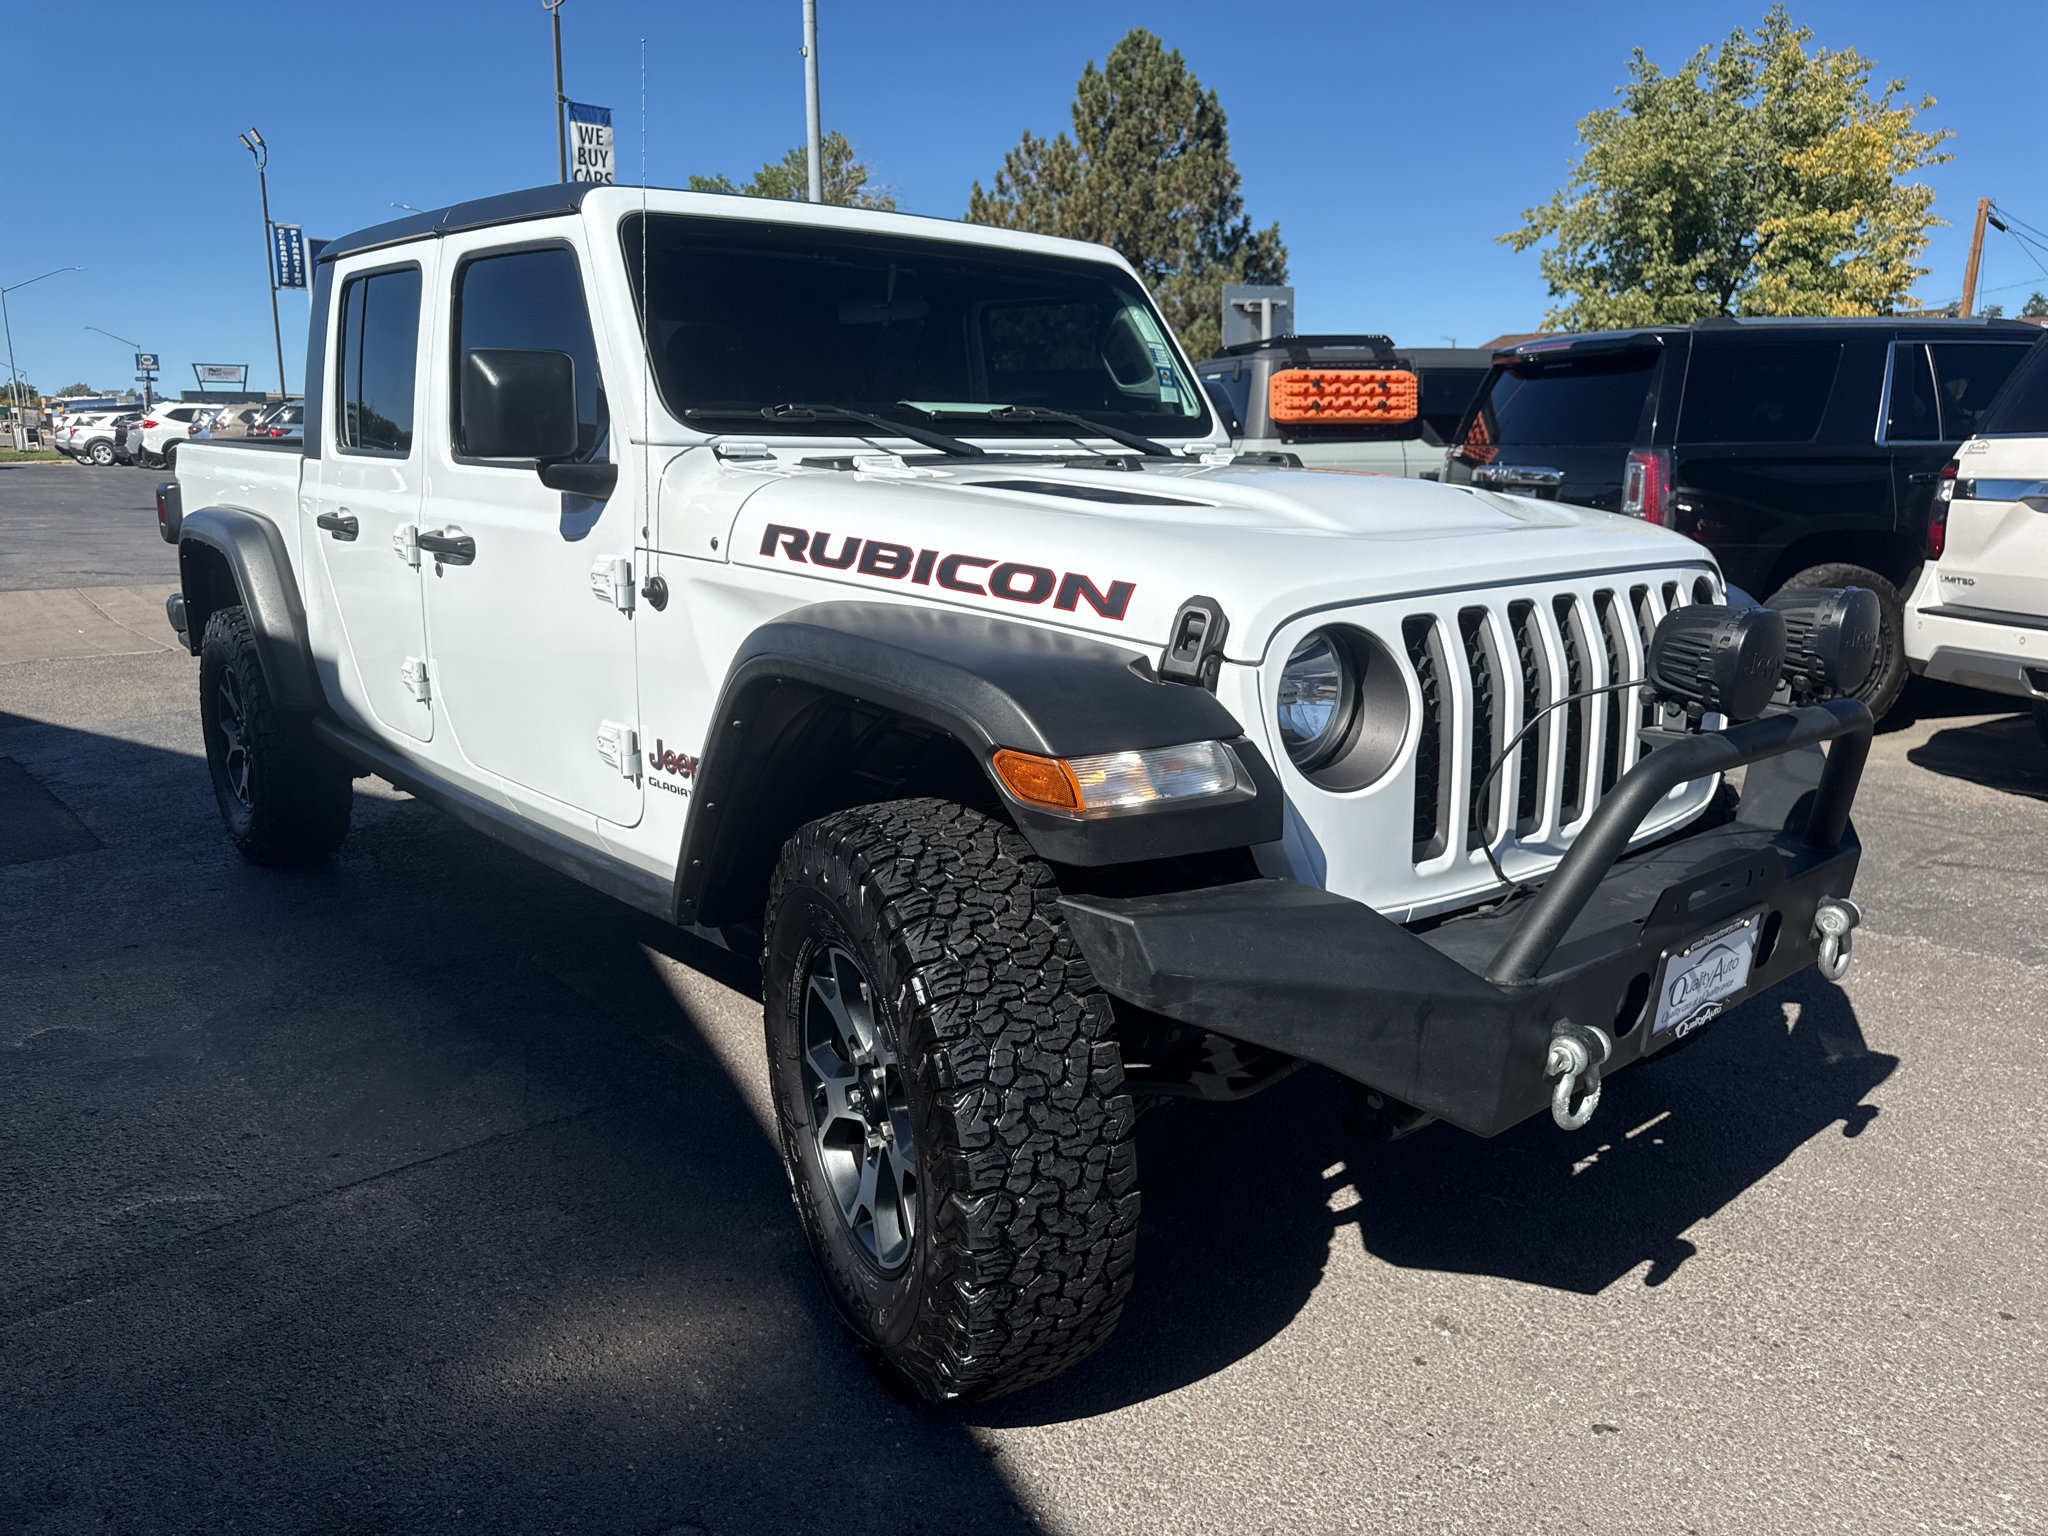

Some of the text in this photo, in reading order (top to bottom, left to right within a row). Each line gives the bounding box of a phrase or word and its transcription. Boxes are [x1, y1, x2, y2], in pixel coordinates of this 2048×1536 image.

[580, 125, 604, 146] WE
[578, 146, 608, 168] BUY
[759, 522, 1136, 621] RUBICON
[1940, 575, 1975, 586] LIMITED
